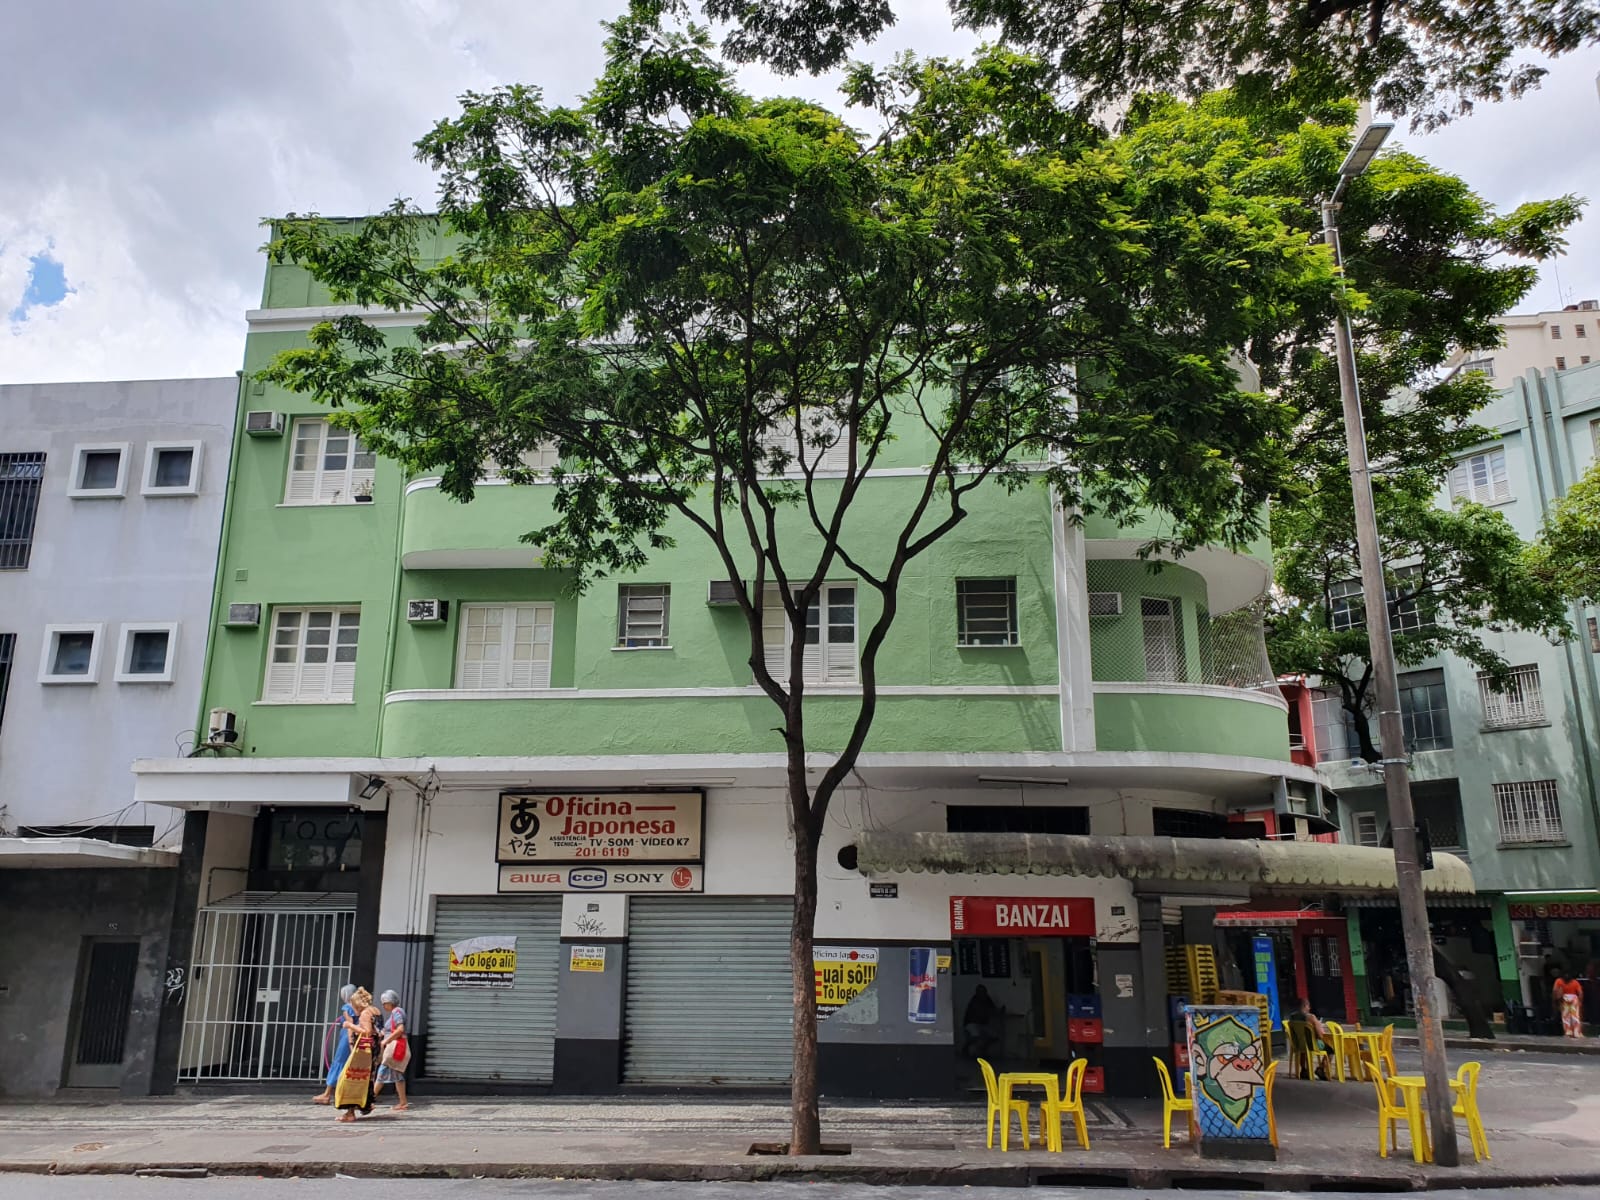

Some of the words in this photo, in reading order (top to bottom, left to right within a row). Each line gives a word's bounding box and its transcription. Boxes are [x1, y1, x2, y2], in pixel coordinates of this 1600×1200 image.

[546, 797, 632, 817] Oficina
[511, 798, 540, 840] あ
[561, 816, 675, 838] Japonesa
[280, 820, 362, 840] TOCA
[590, 838, 603, 847] TV
[608, 838, 634, 847] SOM
[641, 837, 674, 846] VÍDEO
[677, 838, 690, 846] K7
[510, 872, 561, 884] aiwa
[613, 873, 664, 884] SONY
[953, 899, 965, 930] BRAHMA
[996, 904, 1070, 928] BANZAI
[477, 954, 497, 970] logo
[499, 954, 514, 968] ali!
[823, 964, 844, 984] uai
[823, 984, 835, 999] Tô
